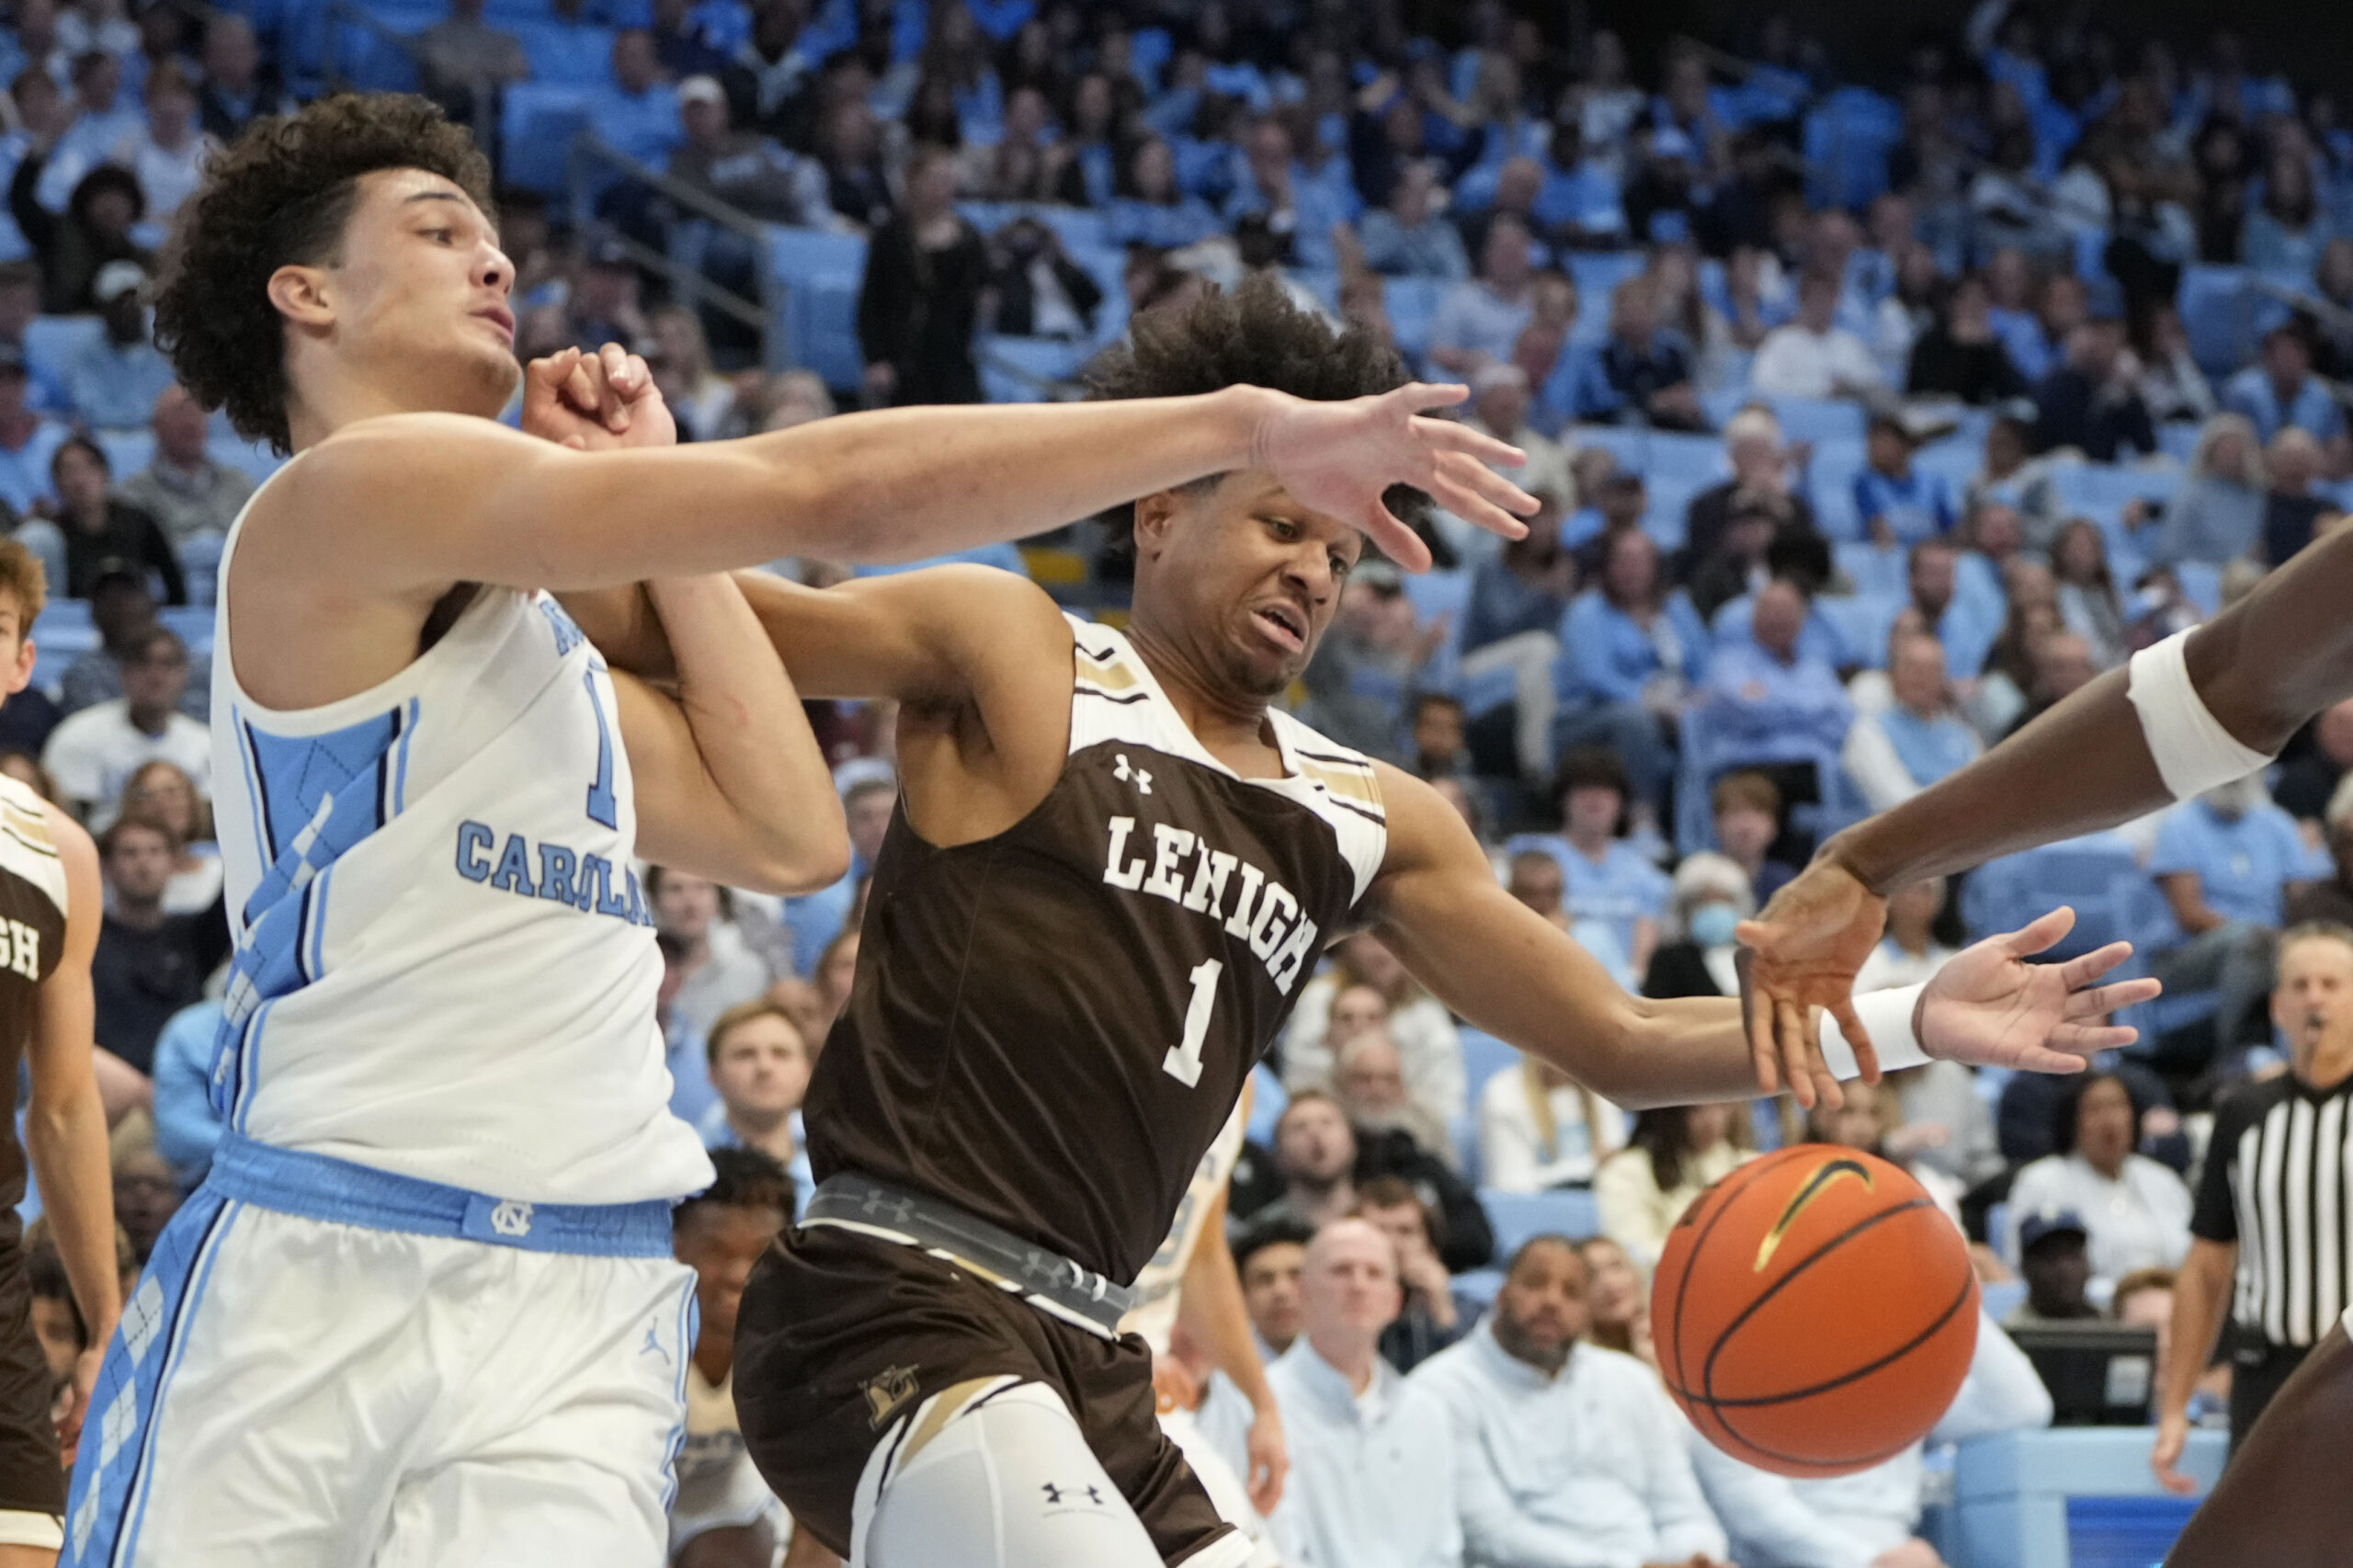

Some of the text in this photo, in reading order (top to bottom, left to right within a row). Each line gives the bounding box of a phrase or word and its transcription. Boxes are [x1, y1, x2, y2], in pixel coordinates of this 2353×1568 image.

[584, 669, 619, 831] 1
[1103, 815, 1318, 996] LEHIGH
[1162, 958, 1223, 1088] 1
